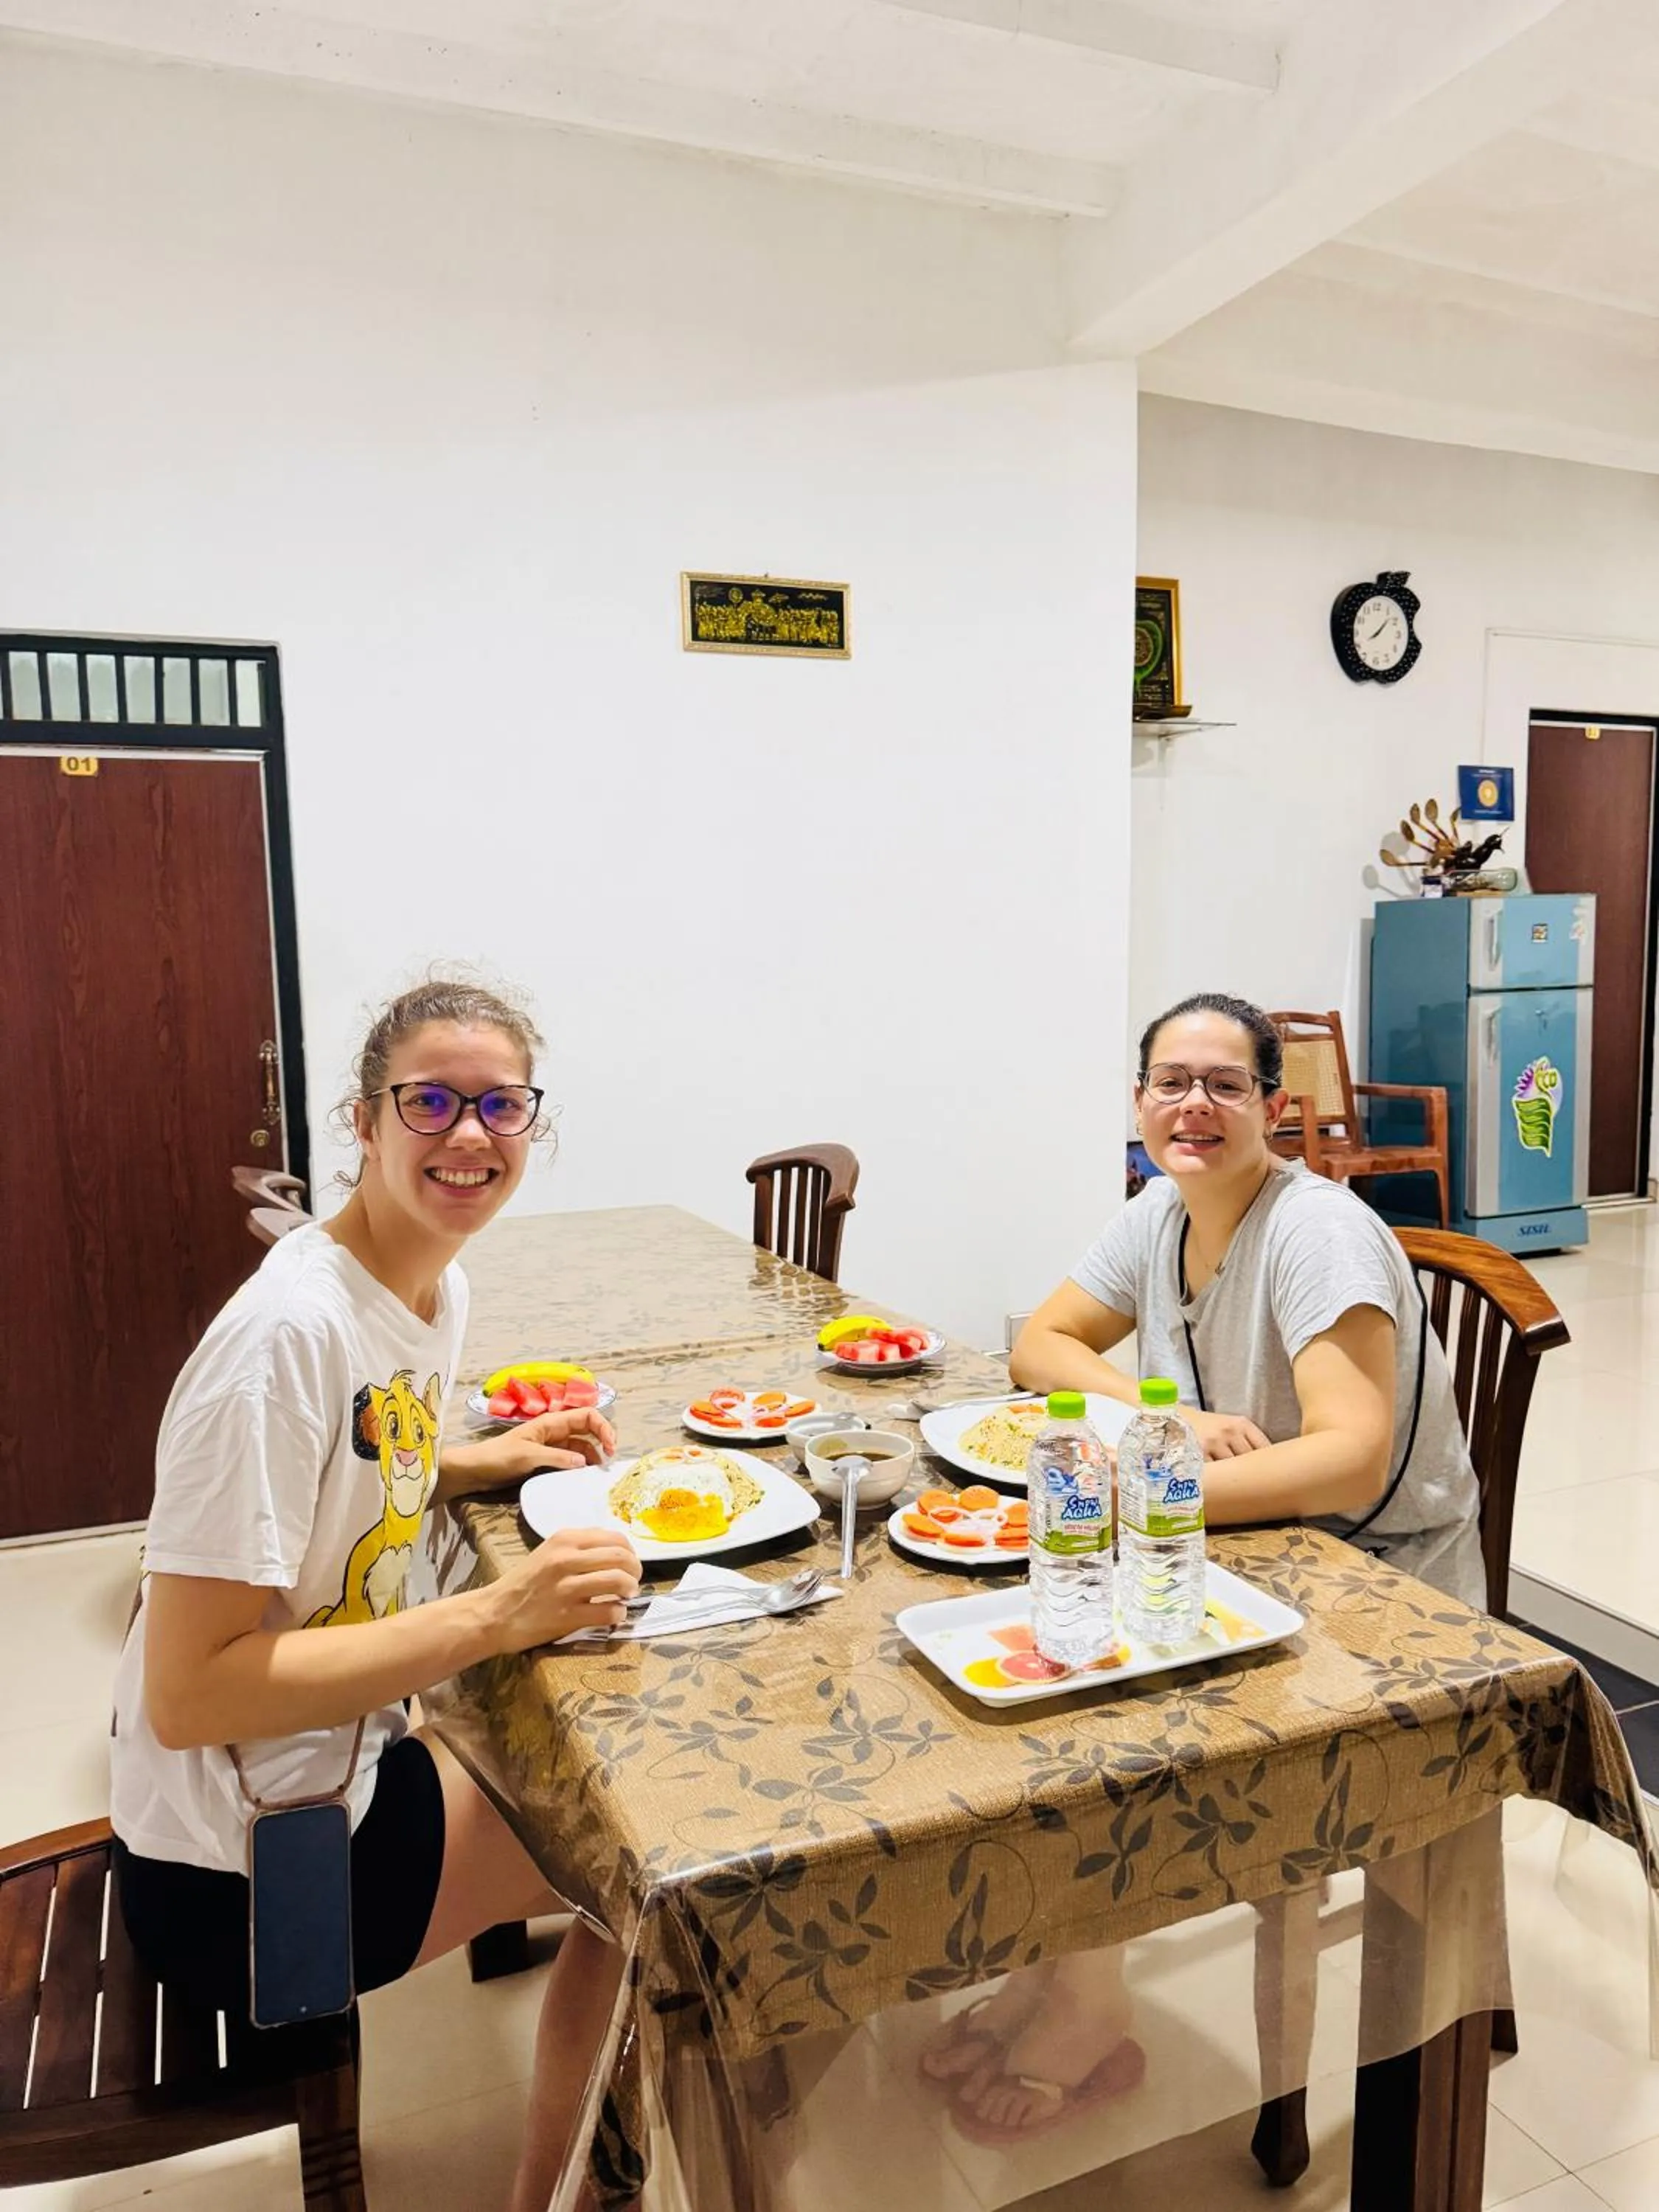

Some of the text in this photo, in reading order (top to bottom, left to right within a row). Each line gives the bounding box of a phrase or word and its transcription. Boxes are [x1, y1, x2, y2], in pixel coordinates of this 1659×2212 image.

[67, 757, 91, 771] 01
[1517, 1224, 1551, 1237] SISIL
[1164, 1486, 1200, 1503] AQUA
[1062, 1504, 1102, 1520] AQUA
